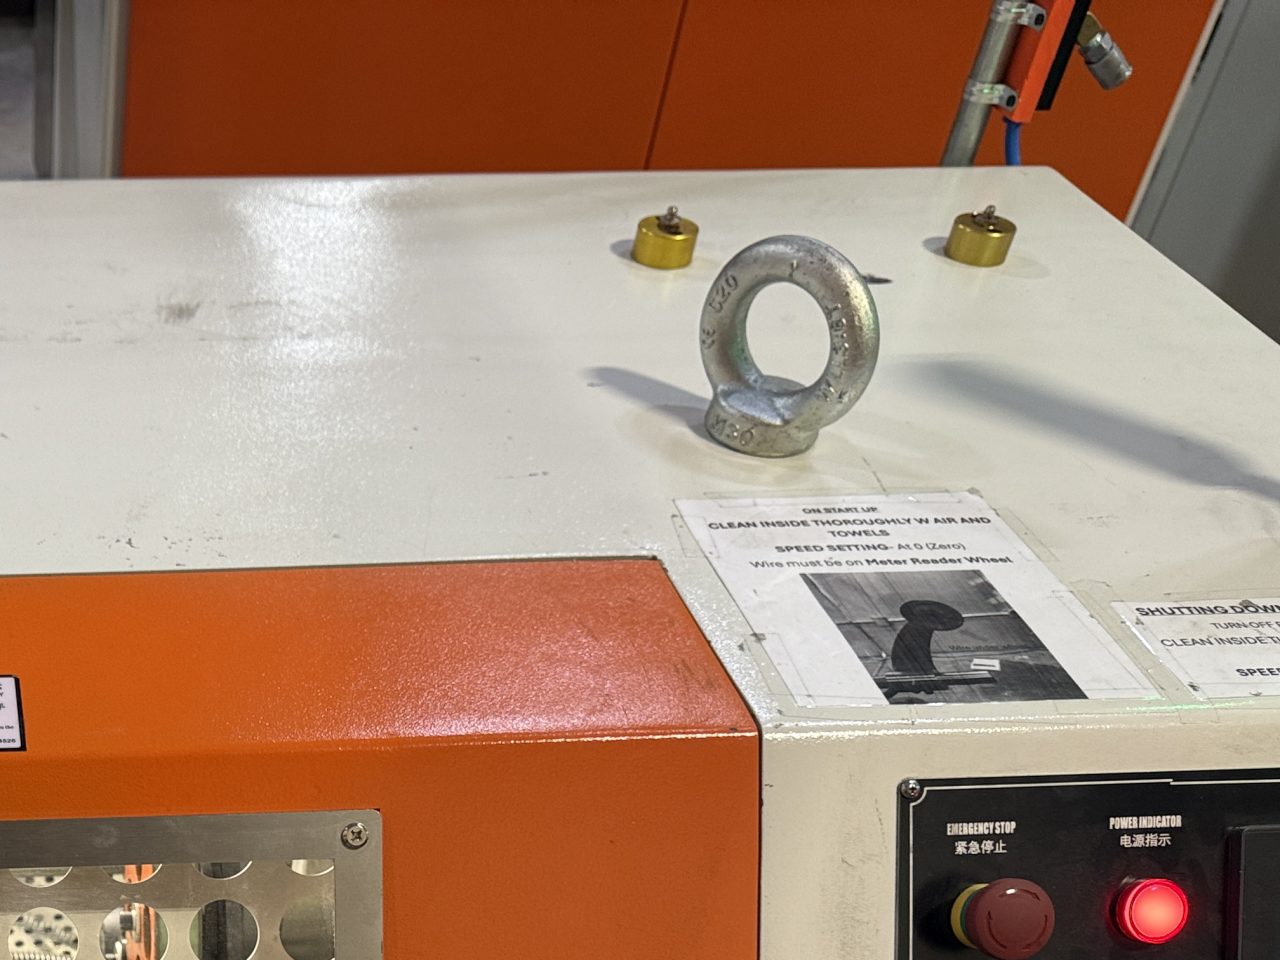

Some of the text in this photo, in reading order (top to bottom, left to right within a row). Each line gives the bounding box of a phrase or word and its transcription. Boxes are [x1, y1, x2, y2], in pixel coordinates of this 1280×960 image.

[708, 516, 992, 529] CLEAN INSIDE THOROUGHLY W AIR AND
[827, 529, 890, 538] TOWELS
[774, 544, 824, 553] SPEED
[897, 542, 911, 550] At
[925, 542, 967, 551] (Zero)
[749, 554, 1014, 568] Wire must be on Meter Reader Wheel
[1135, 605, 1228, 616] SHUTTING
[1210, 621, 1248, 630] TURN
[1249, 620, 1274, 629] OFF
[1160, 638, 1213, 647] CLEAN
[1214, 635, 1266, 645] INSIDE
[947, 821, 1017, 836] EMERGENCY STOP
[1110, 815, 1183, 830] POWER INDICATOR
[1120, 833, 1172, 848] 电源指示
[954, 840, 1008, 855] 紧急停止
